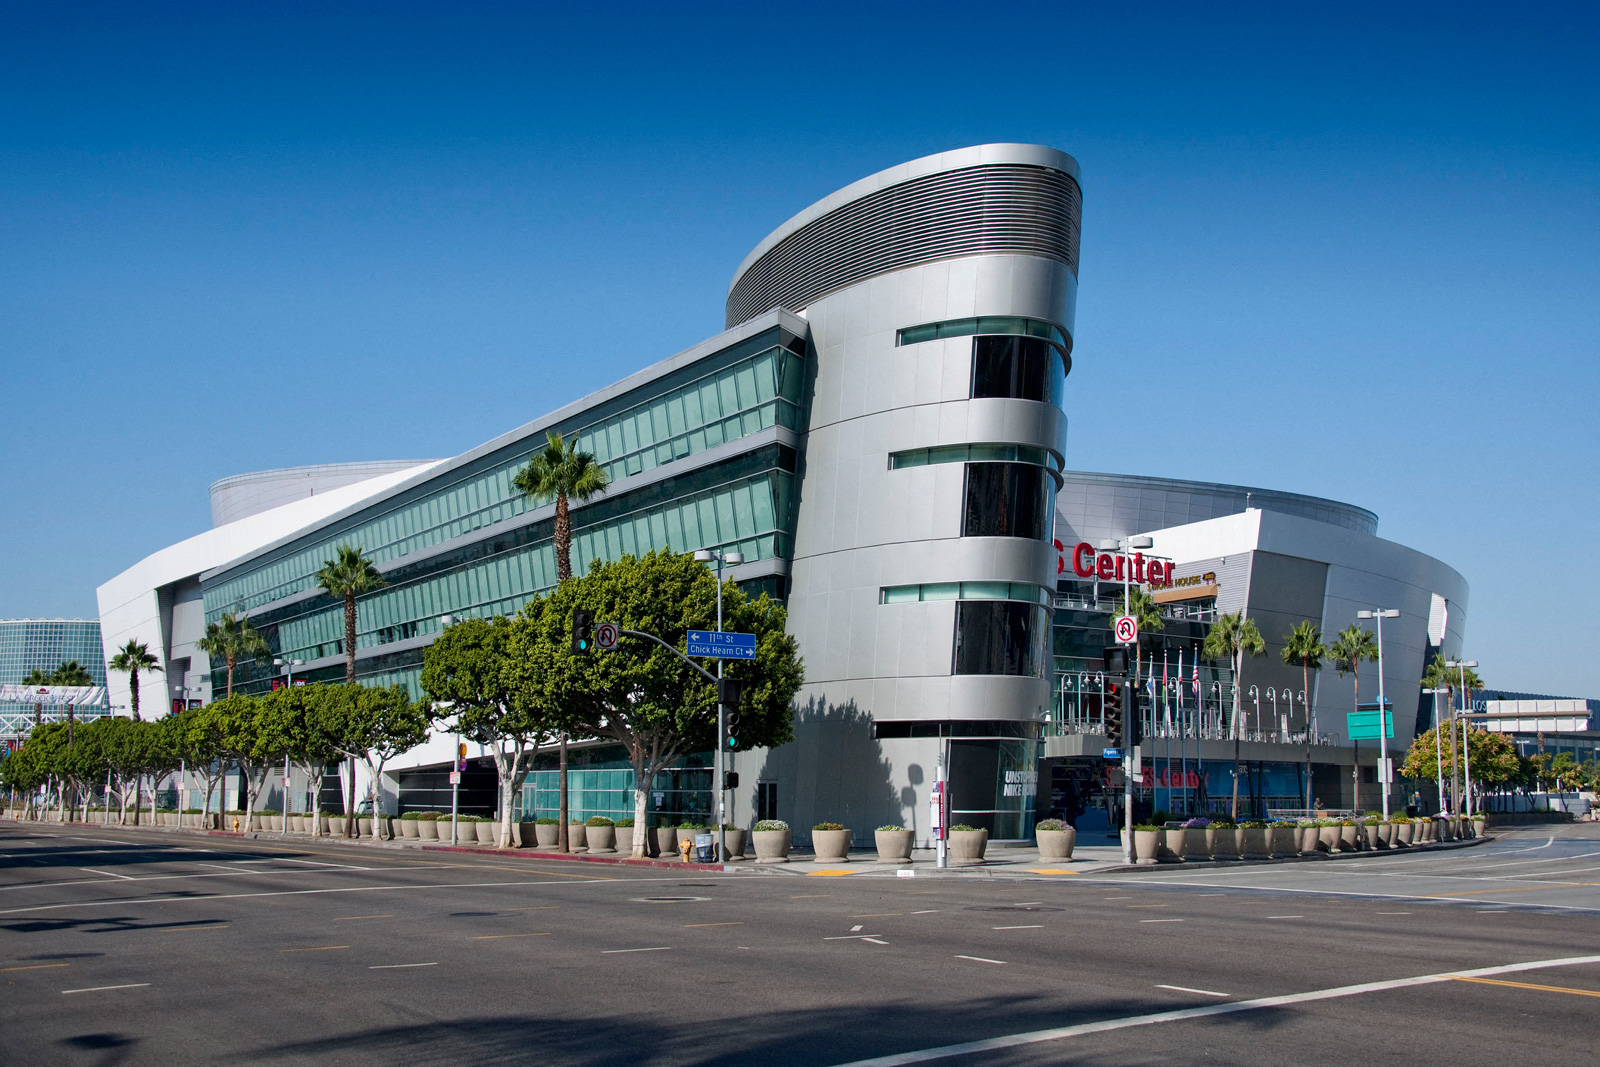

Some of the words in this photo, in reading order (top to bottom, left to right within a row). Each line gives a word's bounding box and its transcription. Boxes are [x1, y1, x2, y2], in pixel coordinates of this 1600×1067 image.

[1073, 542, 1176, 587] Center
[1175, 575, 1201, 588] HOUSE
[709, 633, 722, 643] 11th
[726, 635, 734, 644] St
[690, 645, 710, 654] Chick
[712, 646, 734, 655] Hearn
[736, 647, 743, 656] Ct
[1473, 700, 1487, 711] LOS
[1003, 784, 1022, 797] NIKE
